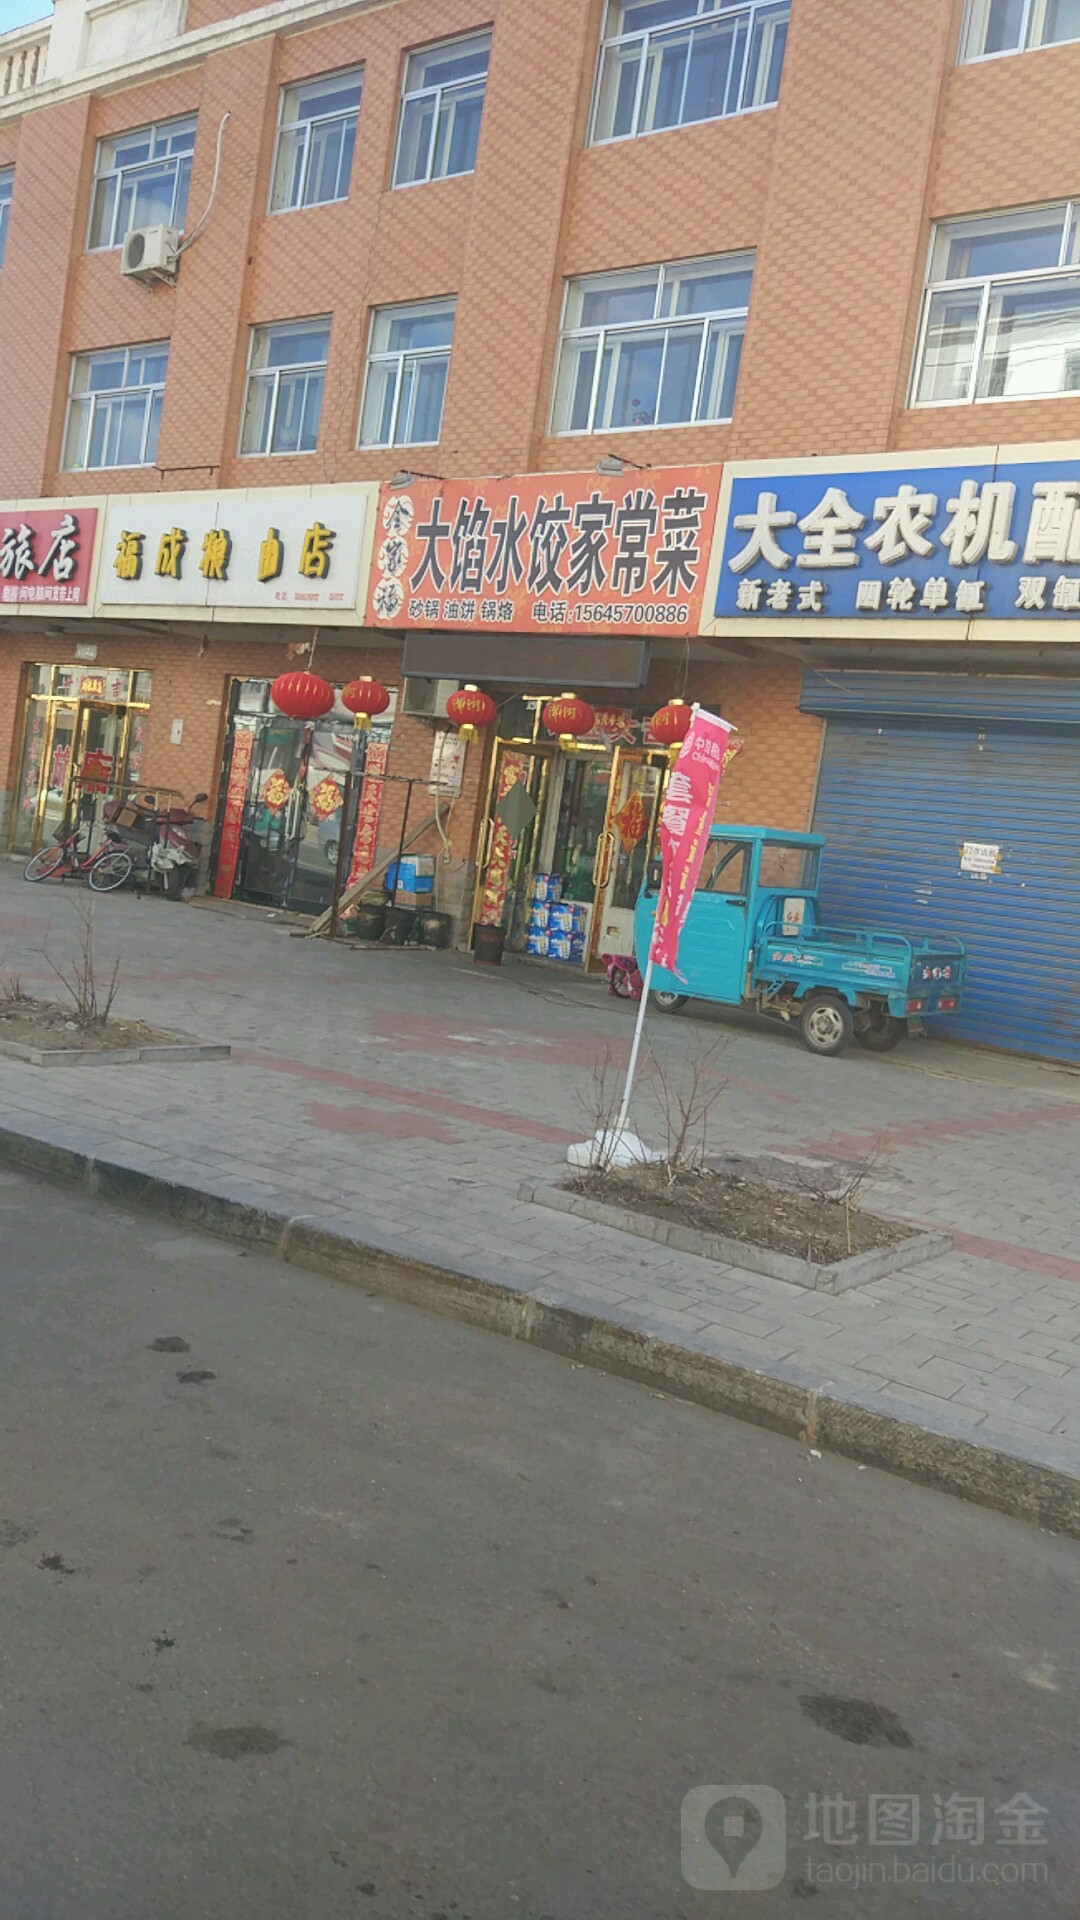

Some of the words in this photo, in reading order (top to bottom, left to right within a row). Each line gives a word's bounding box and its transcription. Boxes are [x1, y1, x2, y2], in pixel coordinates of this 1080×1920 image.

[0, 513, 77, 582] 旅店
[410, 487, 706, 597] 大馅水饺家常菜
[409, 600, 439, 618] 砂锅
[444, 601, 475, 619] 油饼
[481, 600, 513, 620] 锅烙
[532, 601, 689, 623] 电话:15645700886
[736, 578, 826, 612] 新老式
[856, 576, 985, 613] 四轮单缸
